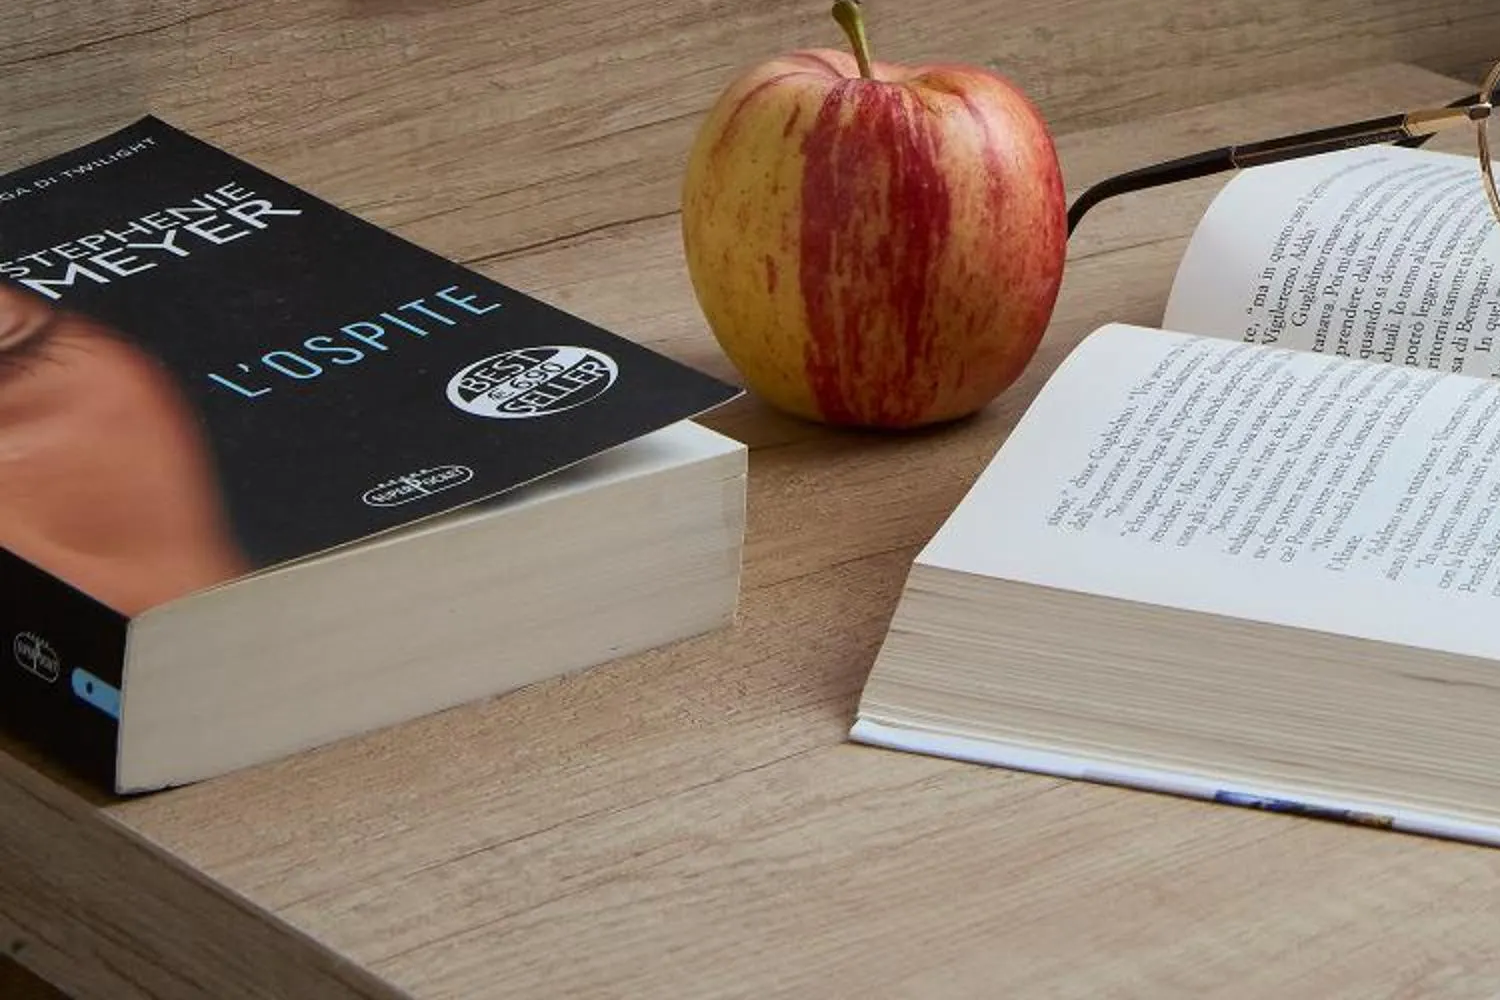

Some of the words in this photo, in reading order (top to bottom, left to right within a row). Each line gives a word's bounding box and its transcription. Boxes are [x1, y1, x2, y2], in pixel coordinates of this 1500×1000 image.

[33, 176, 59, 190] DI
[59, 135, 157, 178] TWILIGHT
[0, 180, 256, 279] STEPHENIE
[18, 198, 303, 300] MEYER
[1258, 266, 1276, 280] in
[1322, 272, 1344, 296] Poi
[1336, 257, 1354, 273] mi
[1374, 242, 1410, 284] devono
[1398, 266, 1422, 298] torno
[1262, 266, 1300, 346] Vigileremo.
[1290, 256, 1328, 327] Guglielmo
[1334, 286, 1366, 357] prendere
[1350, 254, 1378, 283] dalla
[1374, 288, 1388, 297] si
[1411, 272, 1444, 318] leggere
[207, 284, 502, 398] L'OSPITE
[1356, 300, 1384, 359] quando
[1424, 320, 1450, 369] ritorni
[1440, 268, 1468, 317] stanotte
[1402, 322, 1424, 367] potrò
[1450, 336, 1468, 352] di
[1452, 356, 1464, 373] sa
[1474, 336, 1493, 352] In
[459, 350, 541, 393] BEST
[503, 360, 609, 413] SELLER
